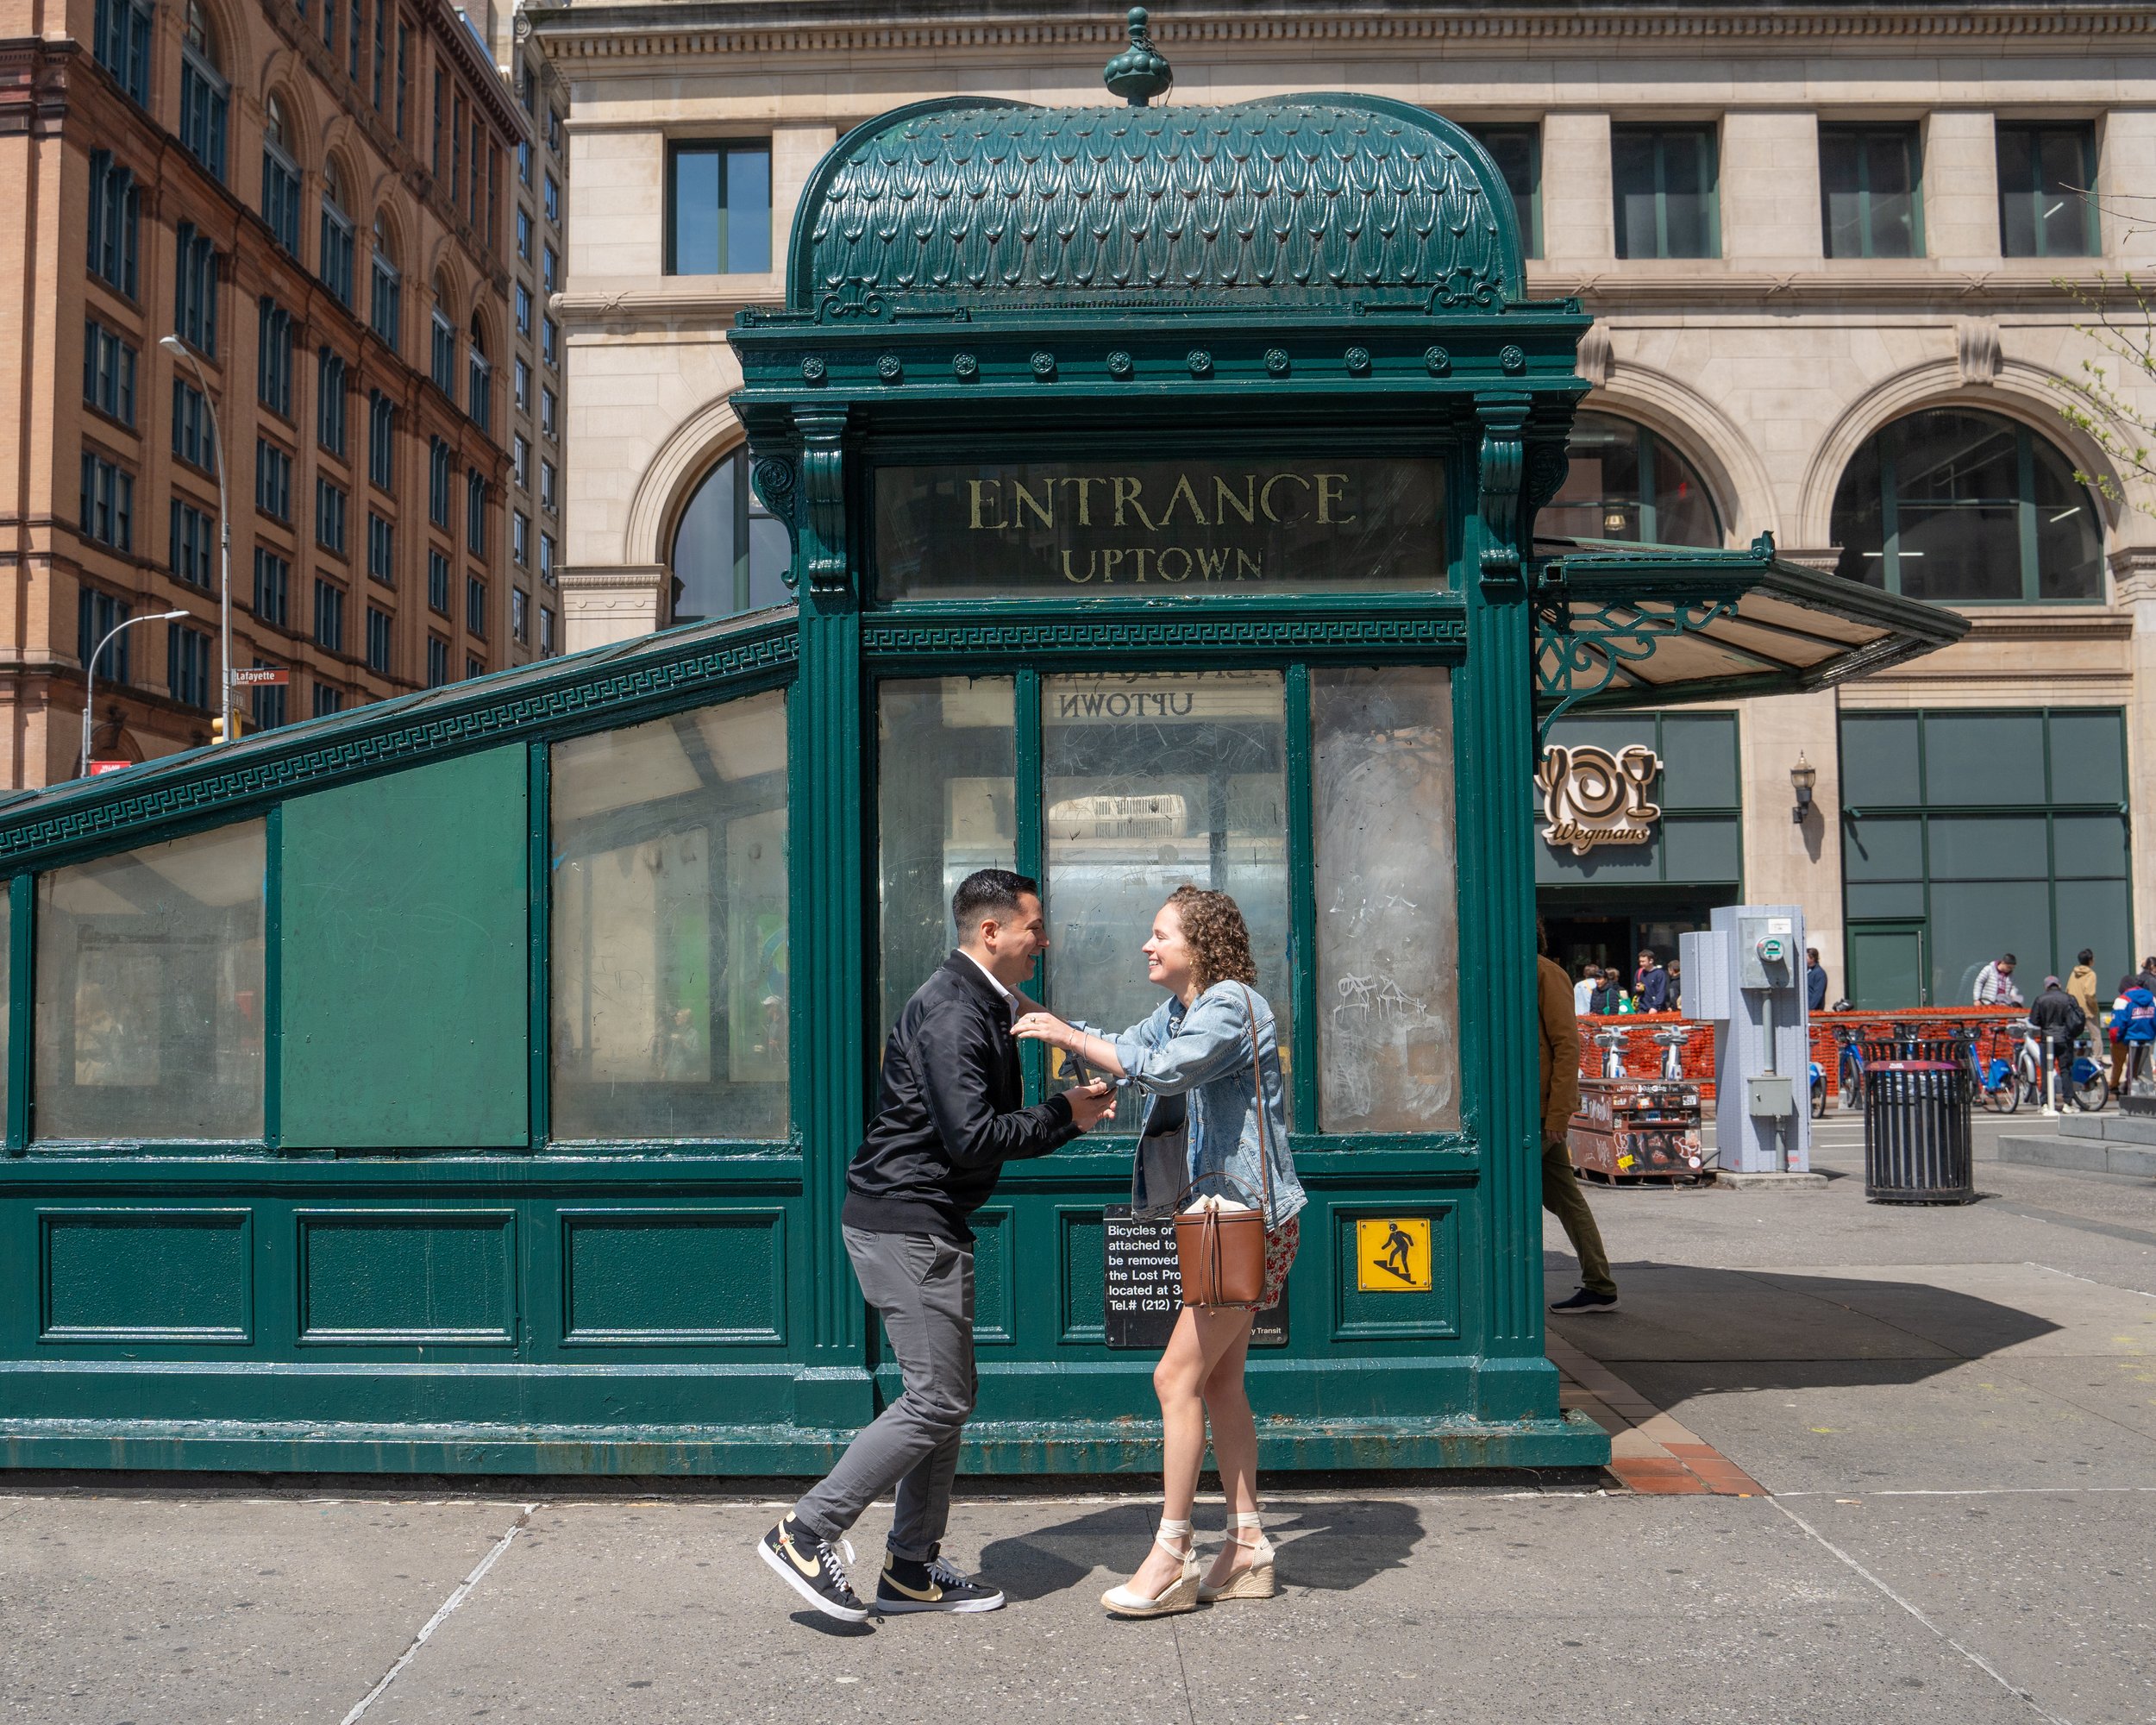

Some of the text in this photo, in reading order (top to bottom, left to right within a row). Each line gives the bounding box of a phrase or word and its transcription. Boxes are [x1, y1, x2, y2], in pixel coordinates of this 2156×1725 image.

[965, 473, 1357, 531] ENTRANCE
[1061, 546, 1263, 583] UPTOWN
[236, 671, 275, 682] Lafayette
[1548, 819, 1648, 850] Wegmans
[1107, 1225, 1174, 1238] Bicycles or
[1108, 1239, 1177, 1251] attached to
[1108, 1254, 1179, 1265] be removed
[1109, 1270, 1128, 1281] the
[1132, 1270, 1158, 1280] Lost
[1109, 1284, 1183, 1295] located at 3
[1109, 1298, 1184, 1311] Tel.# (212) 7
